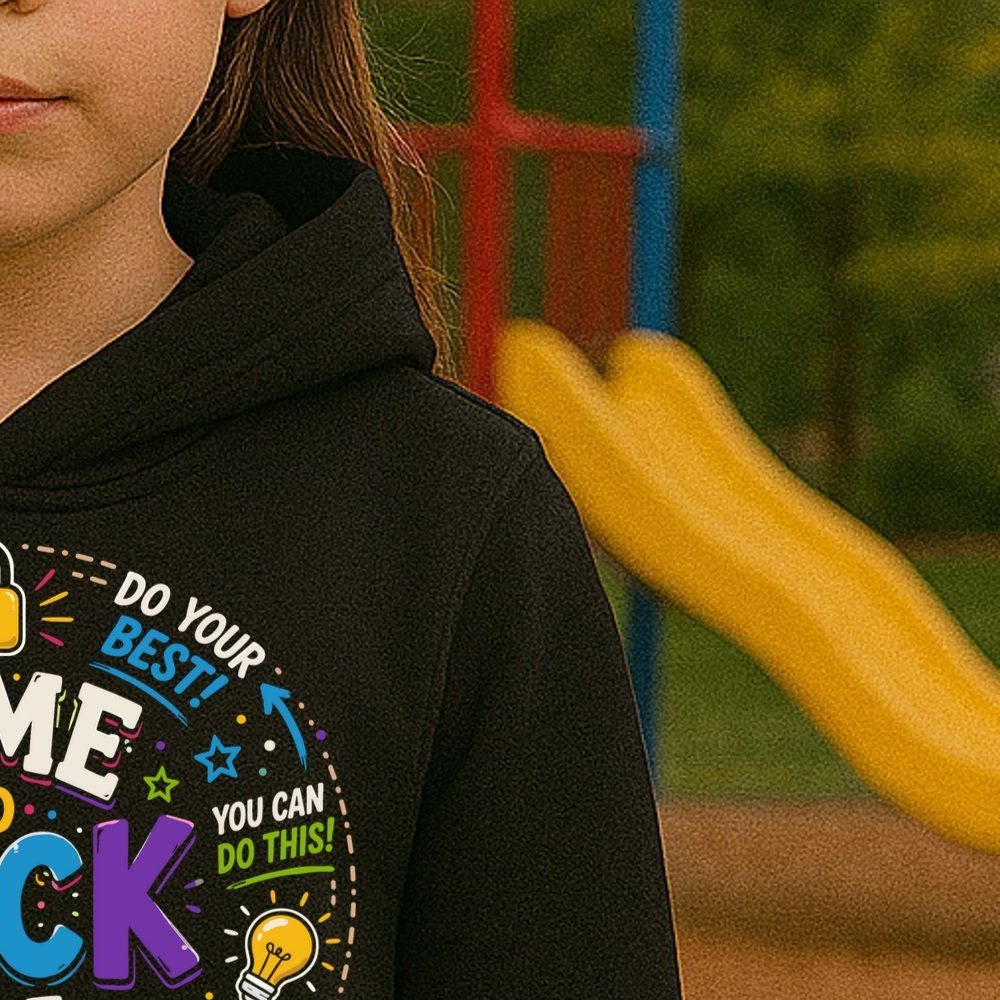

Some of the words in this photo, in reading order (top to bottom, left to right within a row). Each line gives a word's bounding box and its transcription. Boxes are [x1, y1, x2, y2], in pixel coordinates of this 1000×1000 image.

[101, 615, 229, 708] BEST!
[114, 571, 171, 616] DO
[178, 597, 266, 679] YOUR
[212, 800, 263, 835] YOU
[271, 782, 324, 821] CAN
[217, 838, 254, 874] DO
[262, 817, 335, 863] THIS!
